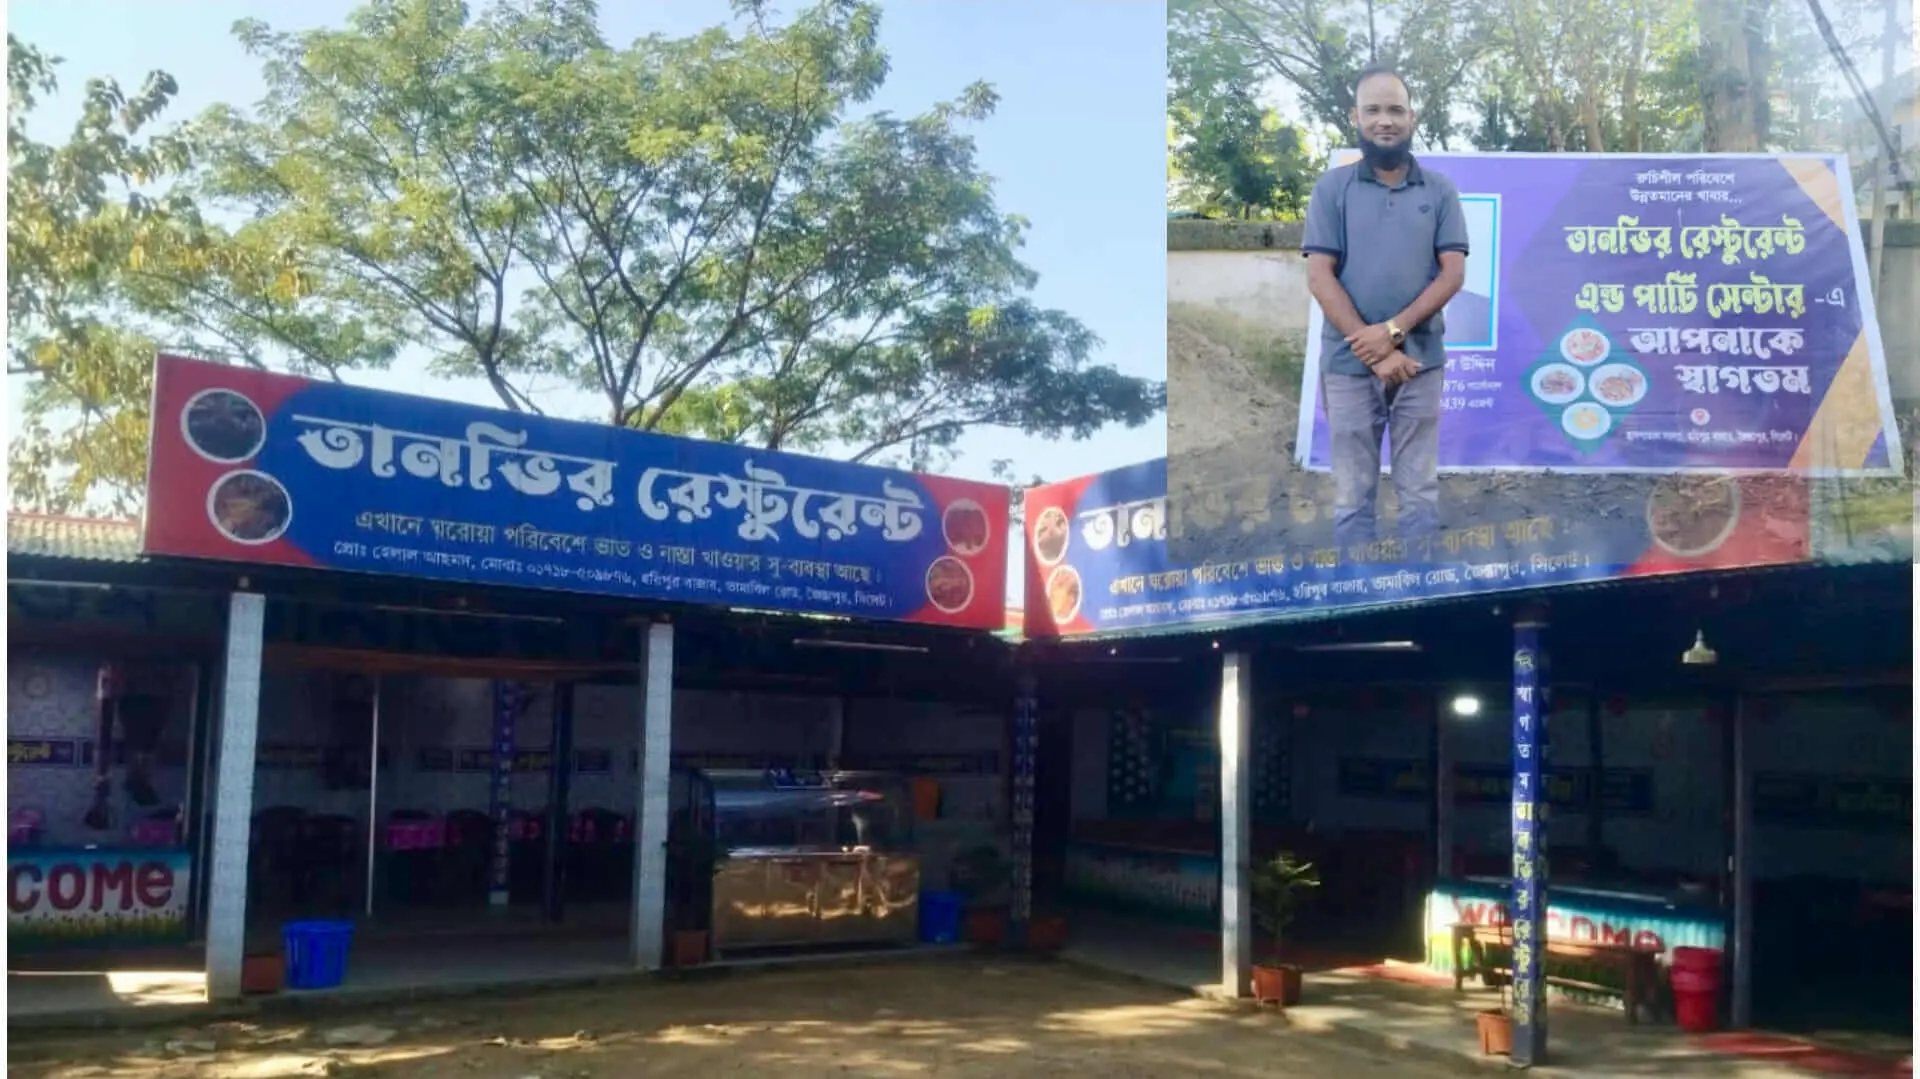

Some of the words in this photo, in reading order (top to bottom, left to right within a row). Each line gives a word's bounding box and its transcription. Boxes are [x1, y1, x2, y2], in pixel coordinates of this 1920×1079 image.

[1686, 169, 1736, 184] পরিবেশে
[1629, 188, 1692, 204] উন্নতমানের
[1564, 215, 1672, 259] তানভির
[1679, 212, 1806, 265] রেস্টুরেন্ট
[1575, 282, 1624, 313] এন্ড
[1633, 271, 1698, 313] পার্টি
[1707, 271, 1806, 318] সেন্টার
[1628, 328, 1804, 358] আপনাকে
[1675, 363, 1812, 395] স্বাগতম
[292, 414, 618, 511] তানভির
[637, 459, 925, 542] রেস্টুরেন্ট
[355, 511, 423, 536] এখানে
[503, 521, 587, 554] পরিবেশে
[593, 536, 631, 558] ভাত
[640, 543, 653, 559] ও
[1191, 559, 1249, 585] পরিবেশে
[1255, 554, 1284, 575] ভাত
